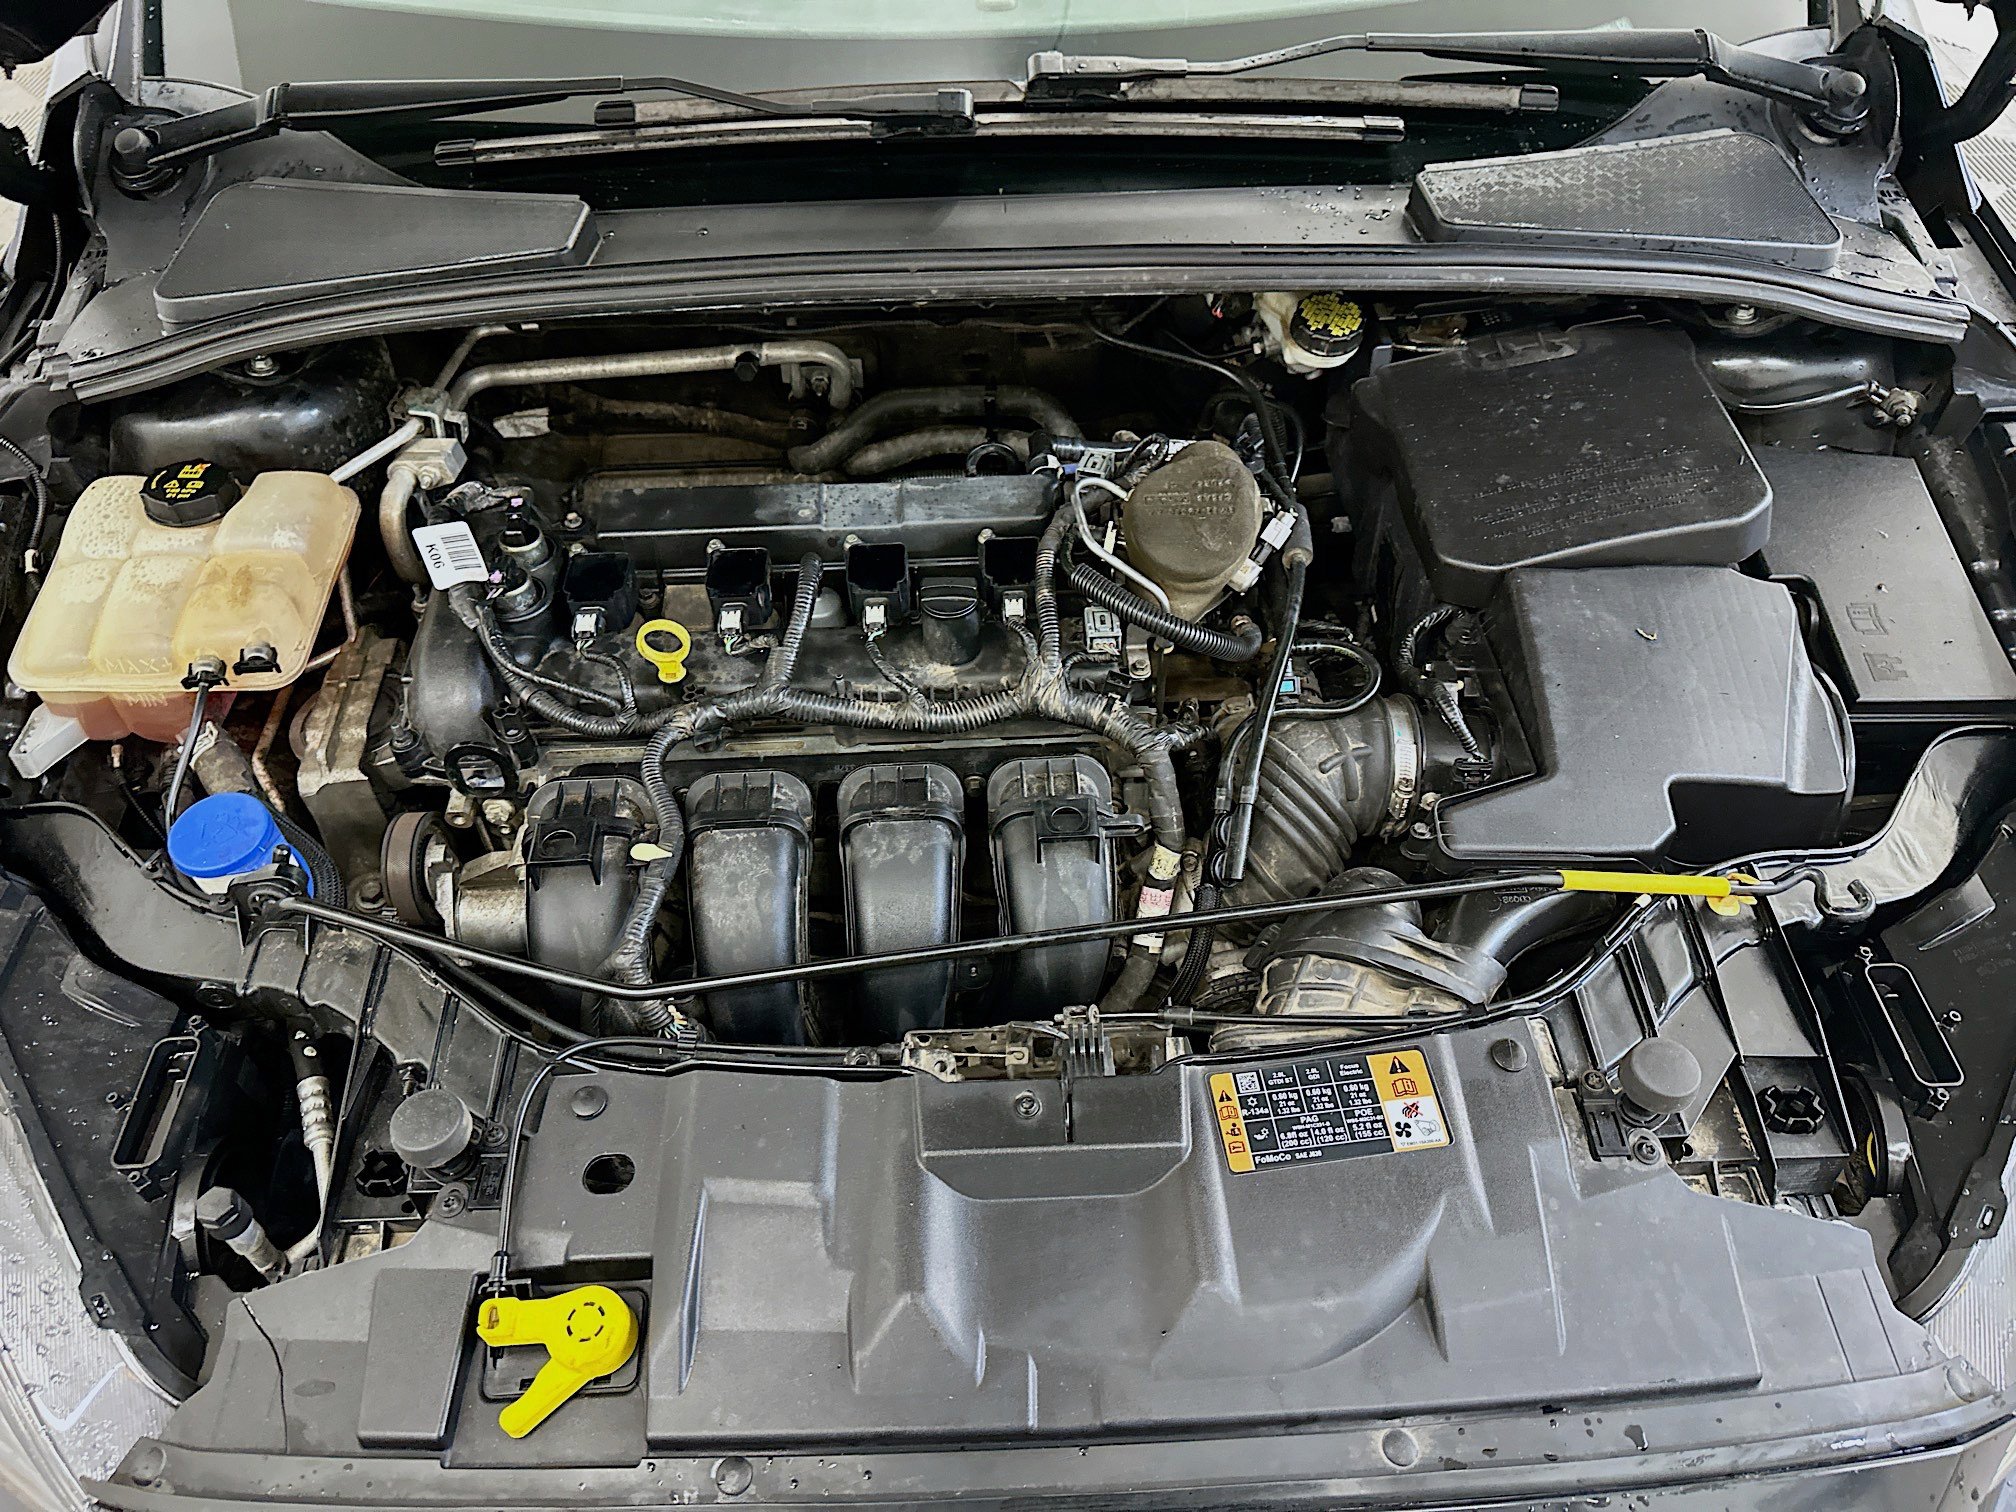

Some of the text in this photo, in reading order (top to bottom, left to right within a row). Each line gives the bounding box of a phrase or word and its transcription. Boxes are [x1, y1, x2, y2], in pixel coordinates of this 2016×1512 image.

[426, 544, 445, 569] K06
[1305, 1087, 1332, 1096] 0.60 kg
[1343, 1083, 1369, 1092] 0.60 kg
[1272, 1091, 1298, 1101] 0.60 kg
[1242, 1107, 1269, 1116] R-134a
[1354, 1108, 1373, 1117] POE
[1300, 1115, 1319, 1123] PAG
[1315, 1127, 1326, 1136] 4.0
[1352, 1123, 1364, 1131] 5.2
[1355, 1128, 1386, 1140] (155 cc)
[1282, 1137, 1312, 1149] (200 cc)
[1317, 1133, 1347, 1145] (120 cc)
[1254, 1153, 1292, 1164] FoMoCo
